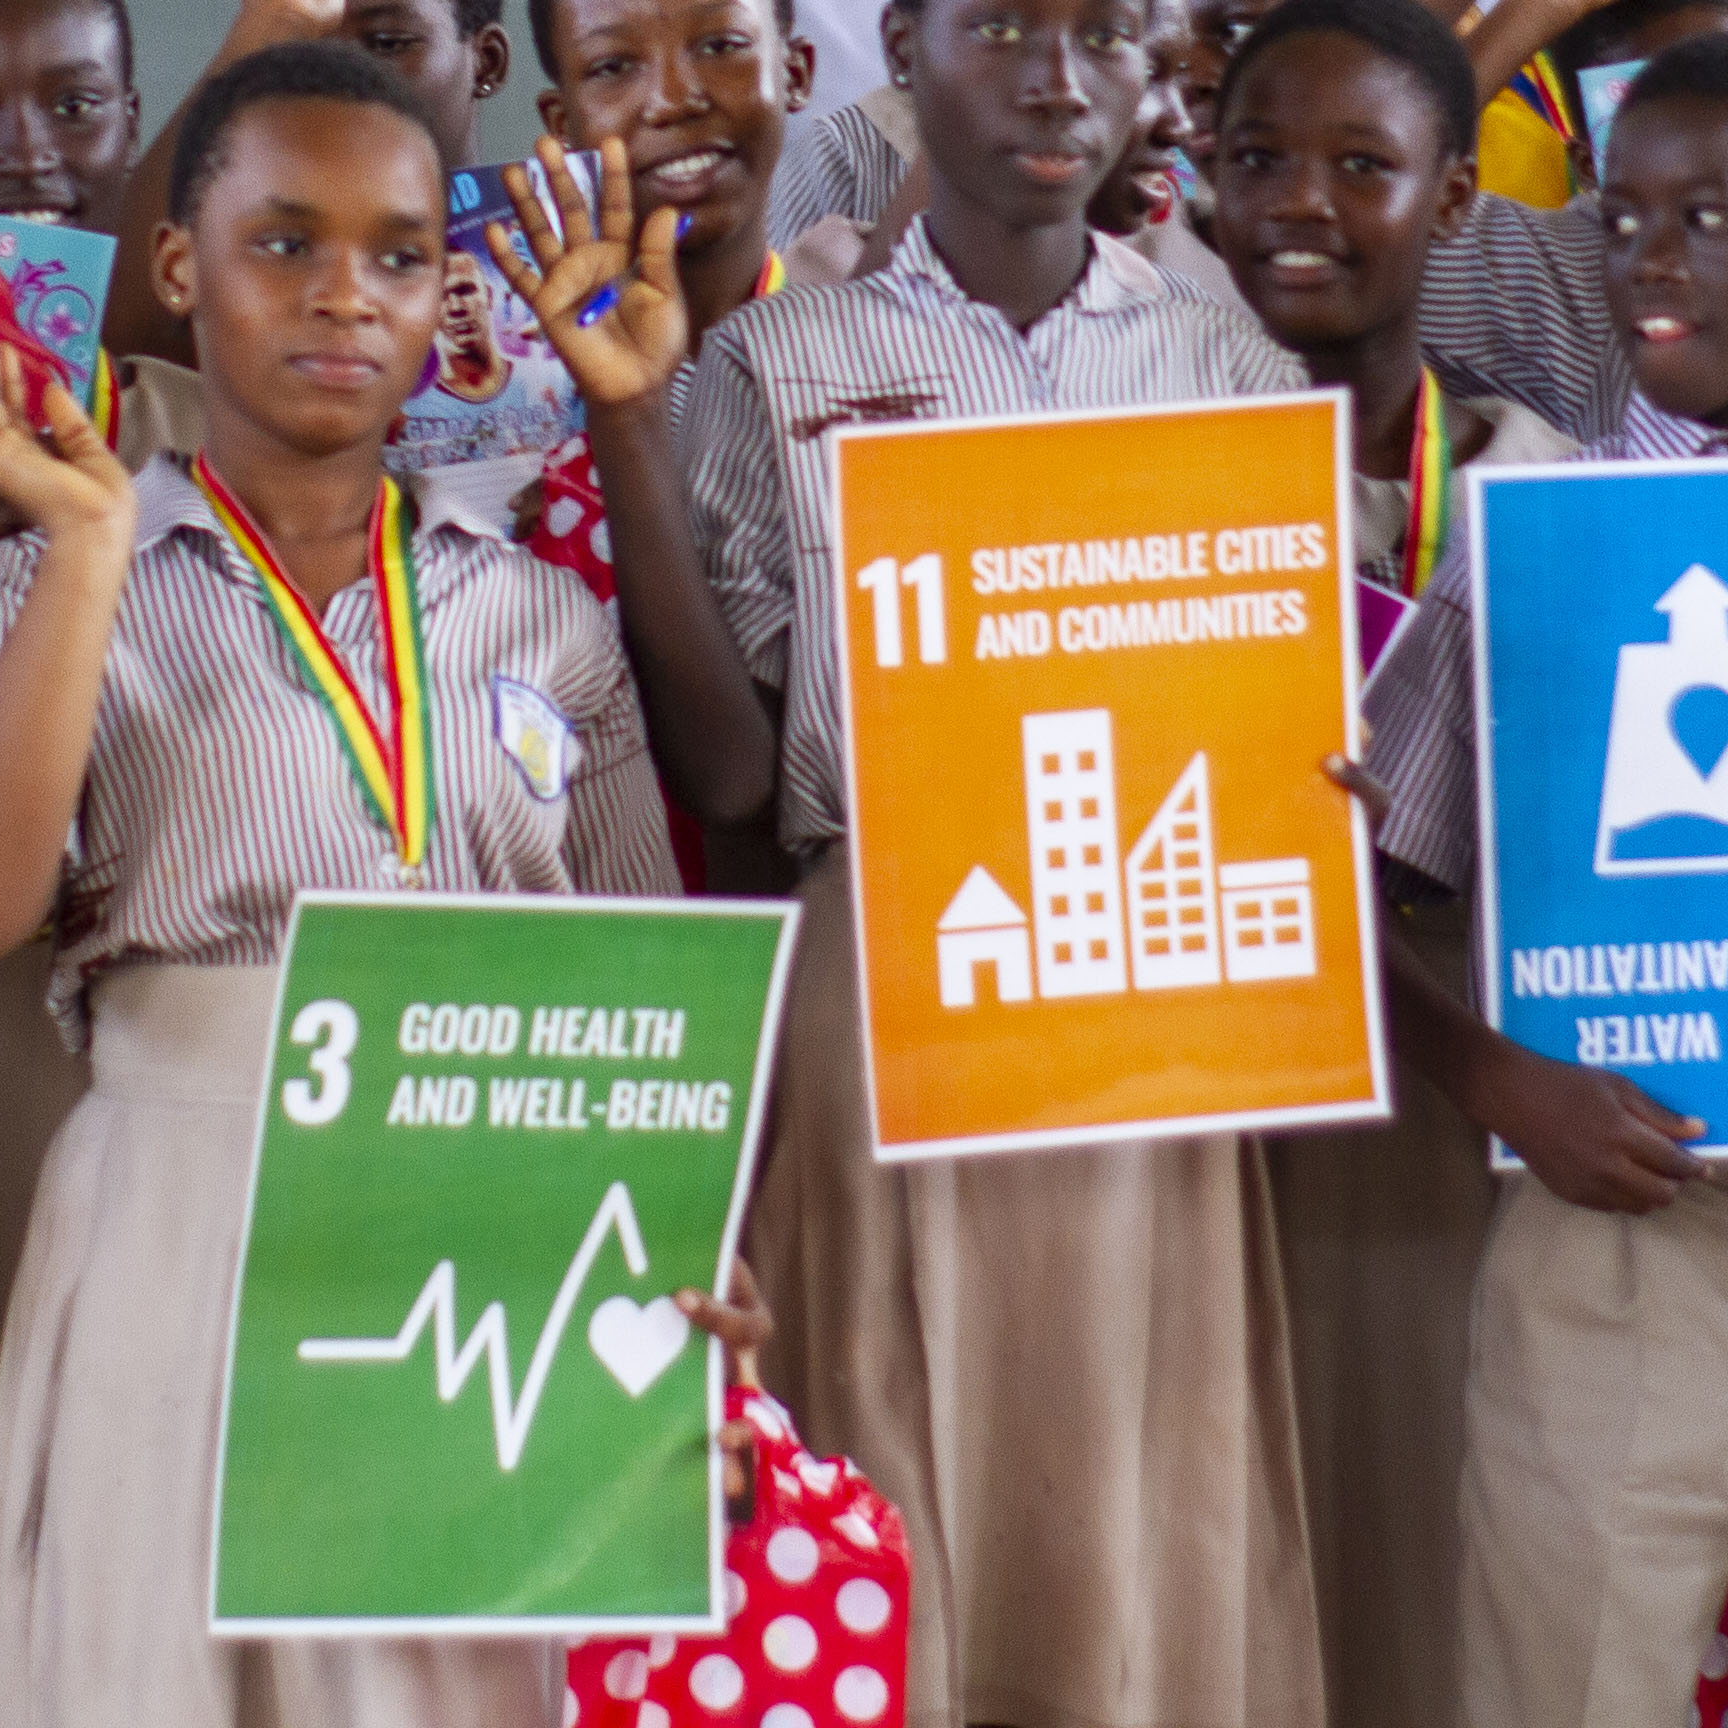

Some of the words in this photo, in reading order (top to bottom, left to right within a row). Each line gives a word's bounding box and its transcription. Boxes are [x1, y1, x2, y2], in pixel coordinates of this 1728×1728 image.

[857, 553, 948, 668] 11
[971, 532, 1209, 595] SUSTAINABLE
[1214, 522, 1328, 575] CITIES
[975, 610, 1050, 661] AND
[1057, 589, 1308, 653] COMMUNITIES
[281, 998, 360, 1127] 3
[398, 1003, 522, 1057] GOOD
[527, 1006, 687, 1060] HEALTH
[1574, 1012, 1720, 1066] WATER
[385, 1074, 479, 1127] AND
[488, 1076, 733, 1132] WELL-BEING
